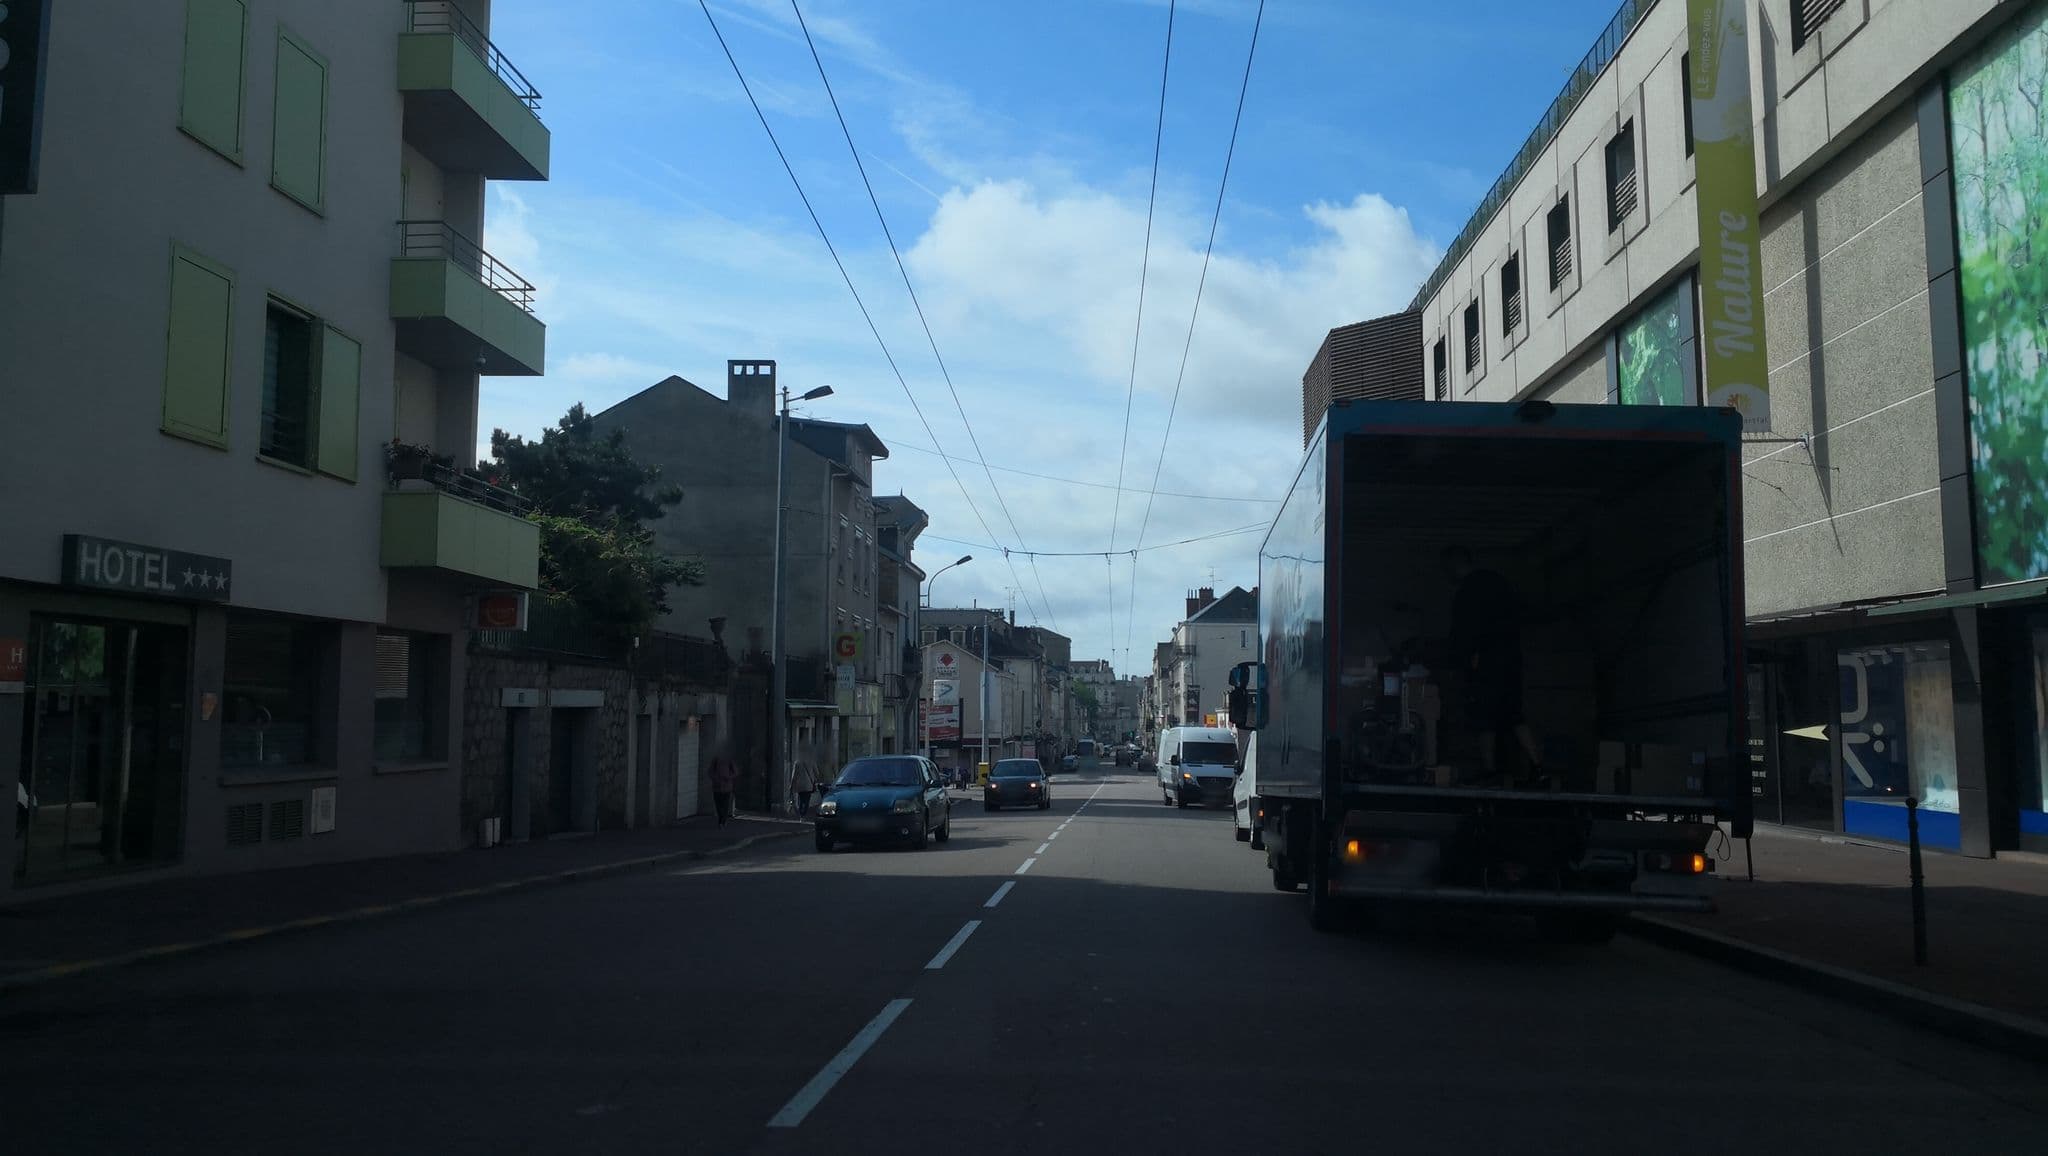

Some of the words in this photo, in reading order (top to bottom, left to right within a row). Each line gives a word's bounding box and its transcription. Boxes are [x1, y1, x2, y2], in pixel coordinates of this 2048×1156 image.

[1712, 208, 1754, 359] Nature
[80, 541, 176, 591] HOTEL
[836, 635, 856, 657] G
